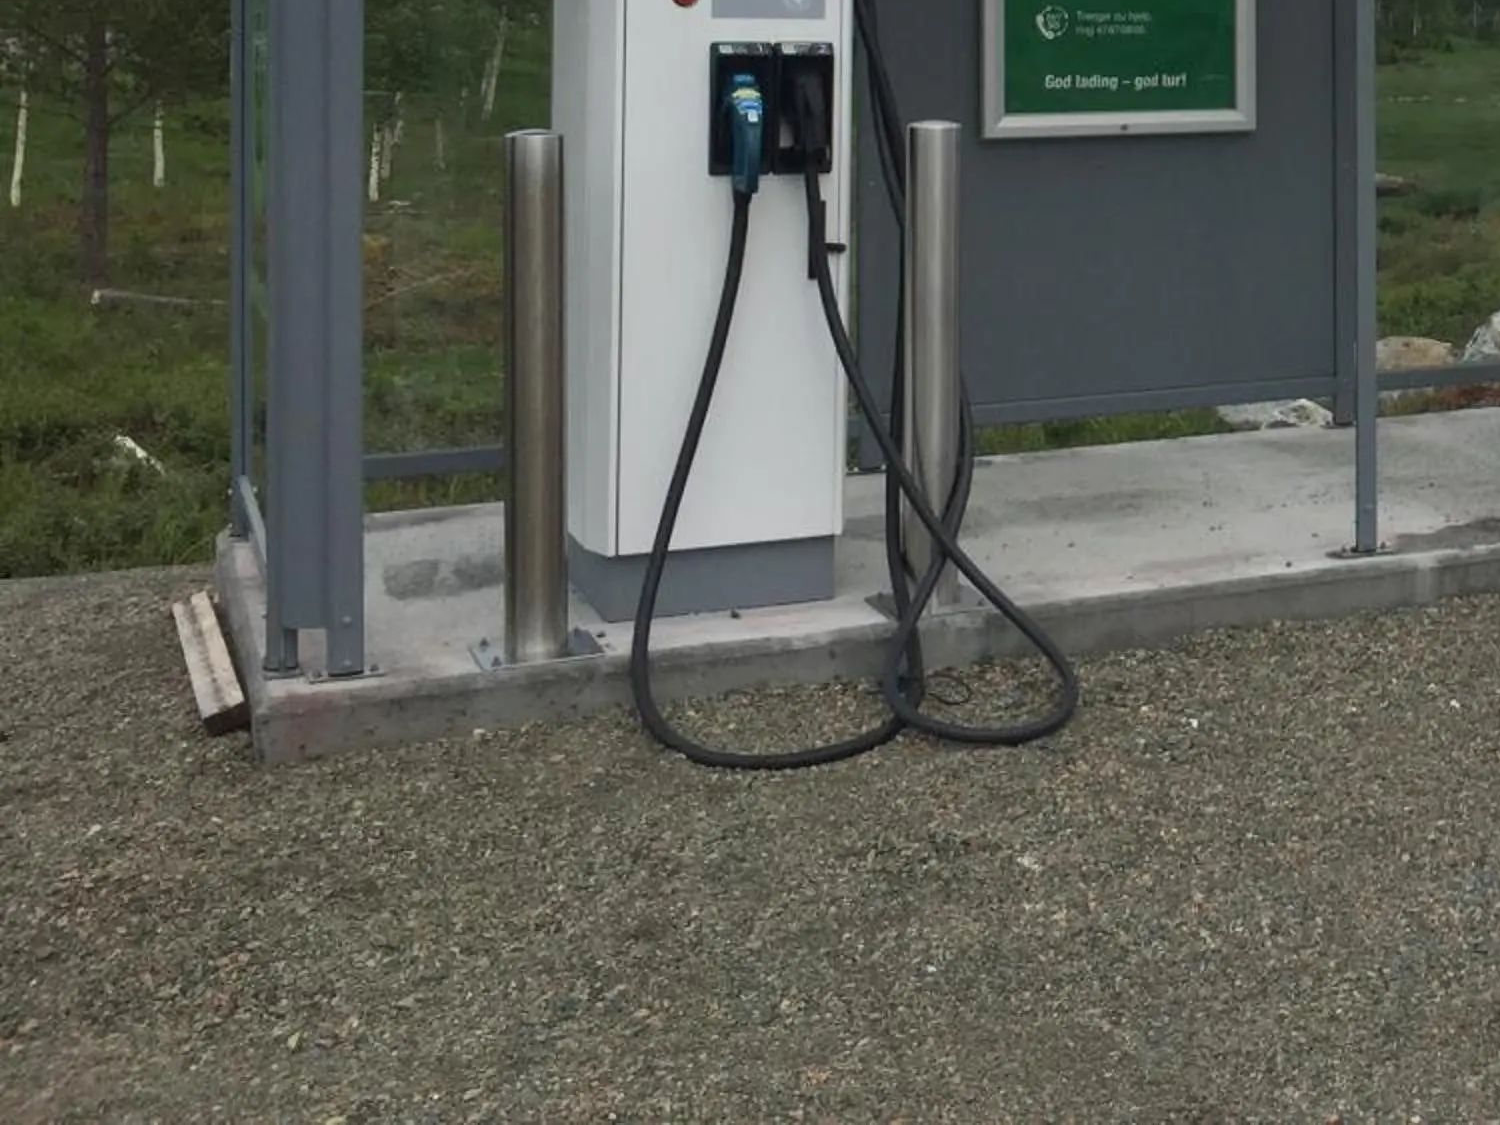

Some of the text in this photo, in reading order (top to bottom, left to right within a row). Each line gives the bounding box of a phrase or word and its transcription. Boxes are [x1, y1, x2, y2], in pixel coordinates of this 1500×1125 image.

[1044, 74, 1073, 89] God
[1075, 74, 1119, 91] lading
[1134, 73, 1159, 91] god
[1161, 72, 1187, 88] tur!
